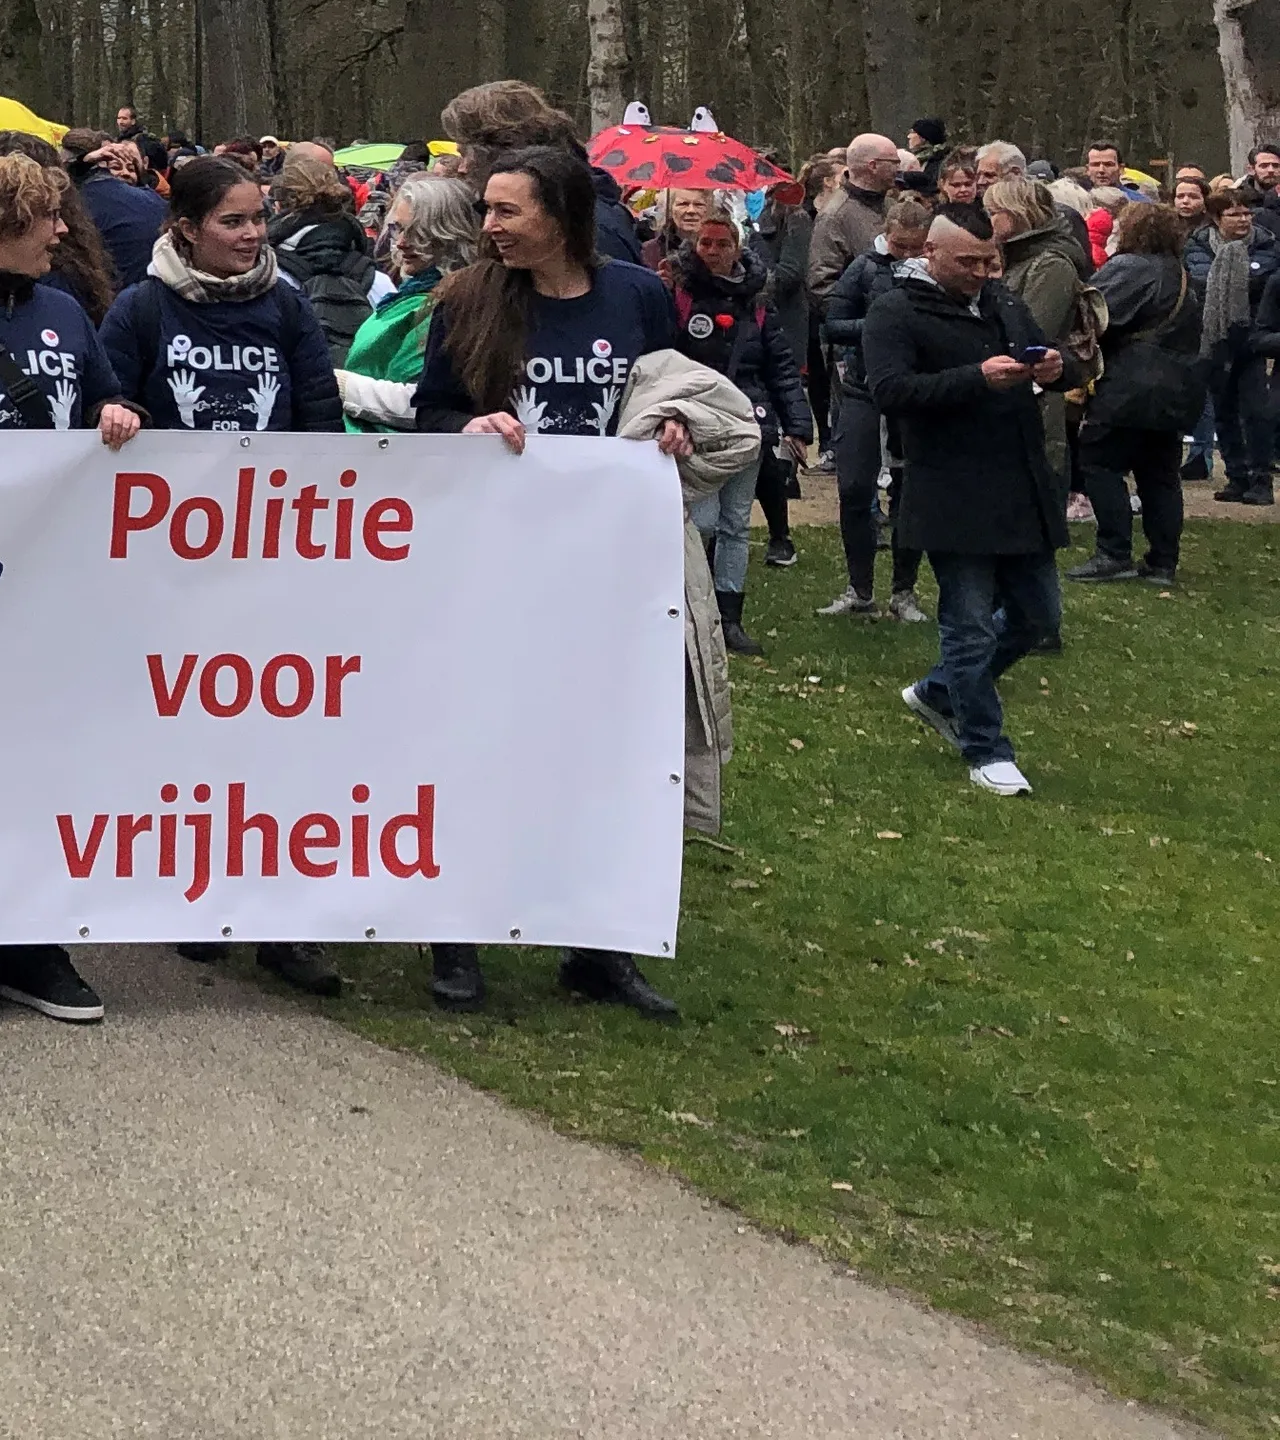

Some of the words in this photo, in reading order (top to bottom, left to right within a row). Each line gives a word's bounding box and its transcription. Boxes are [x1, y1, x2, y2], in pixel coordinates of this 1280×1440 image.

[167, 344, 280, 372] POLICE
[519, 356, 629, 384] OLICE
[211, 420, 241, 431] FOR
[109, 466, 414, 561] Politie
[146, 652, 361, 718] voor
[56, 782, 441, 903] vrijheid
